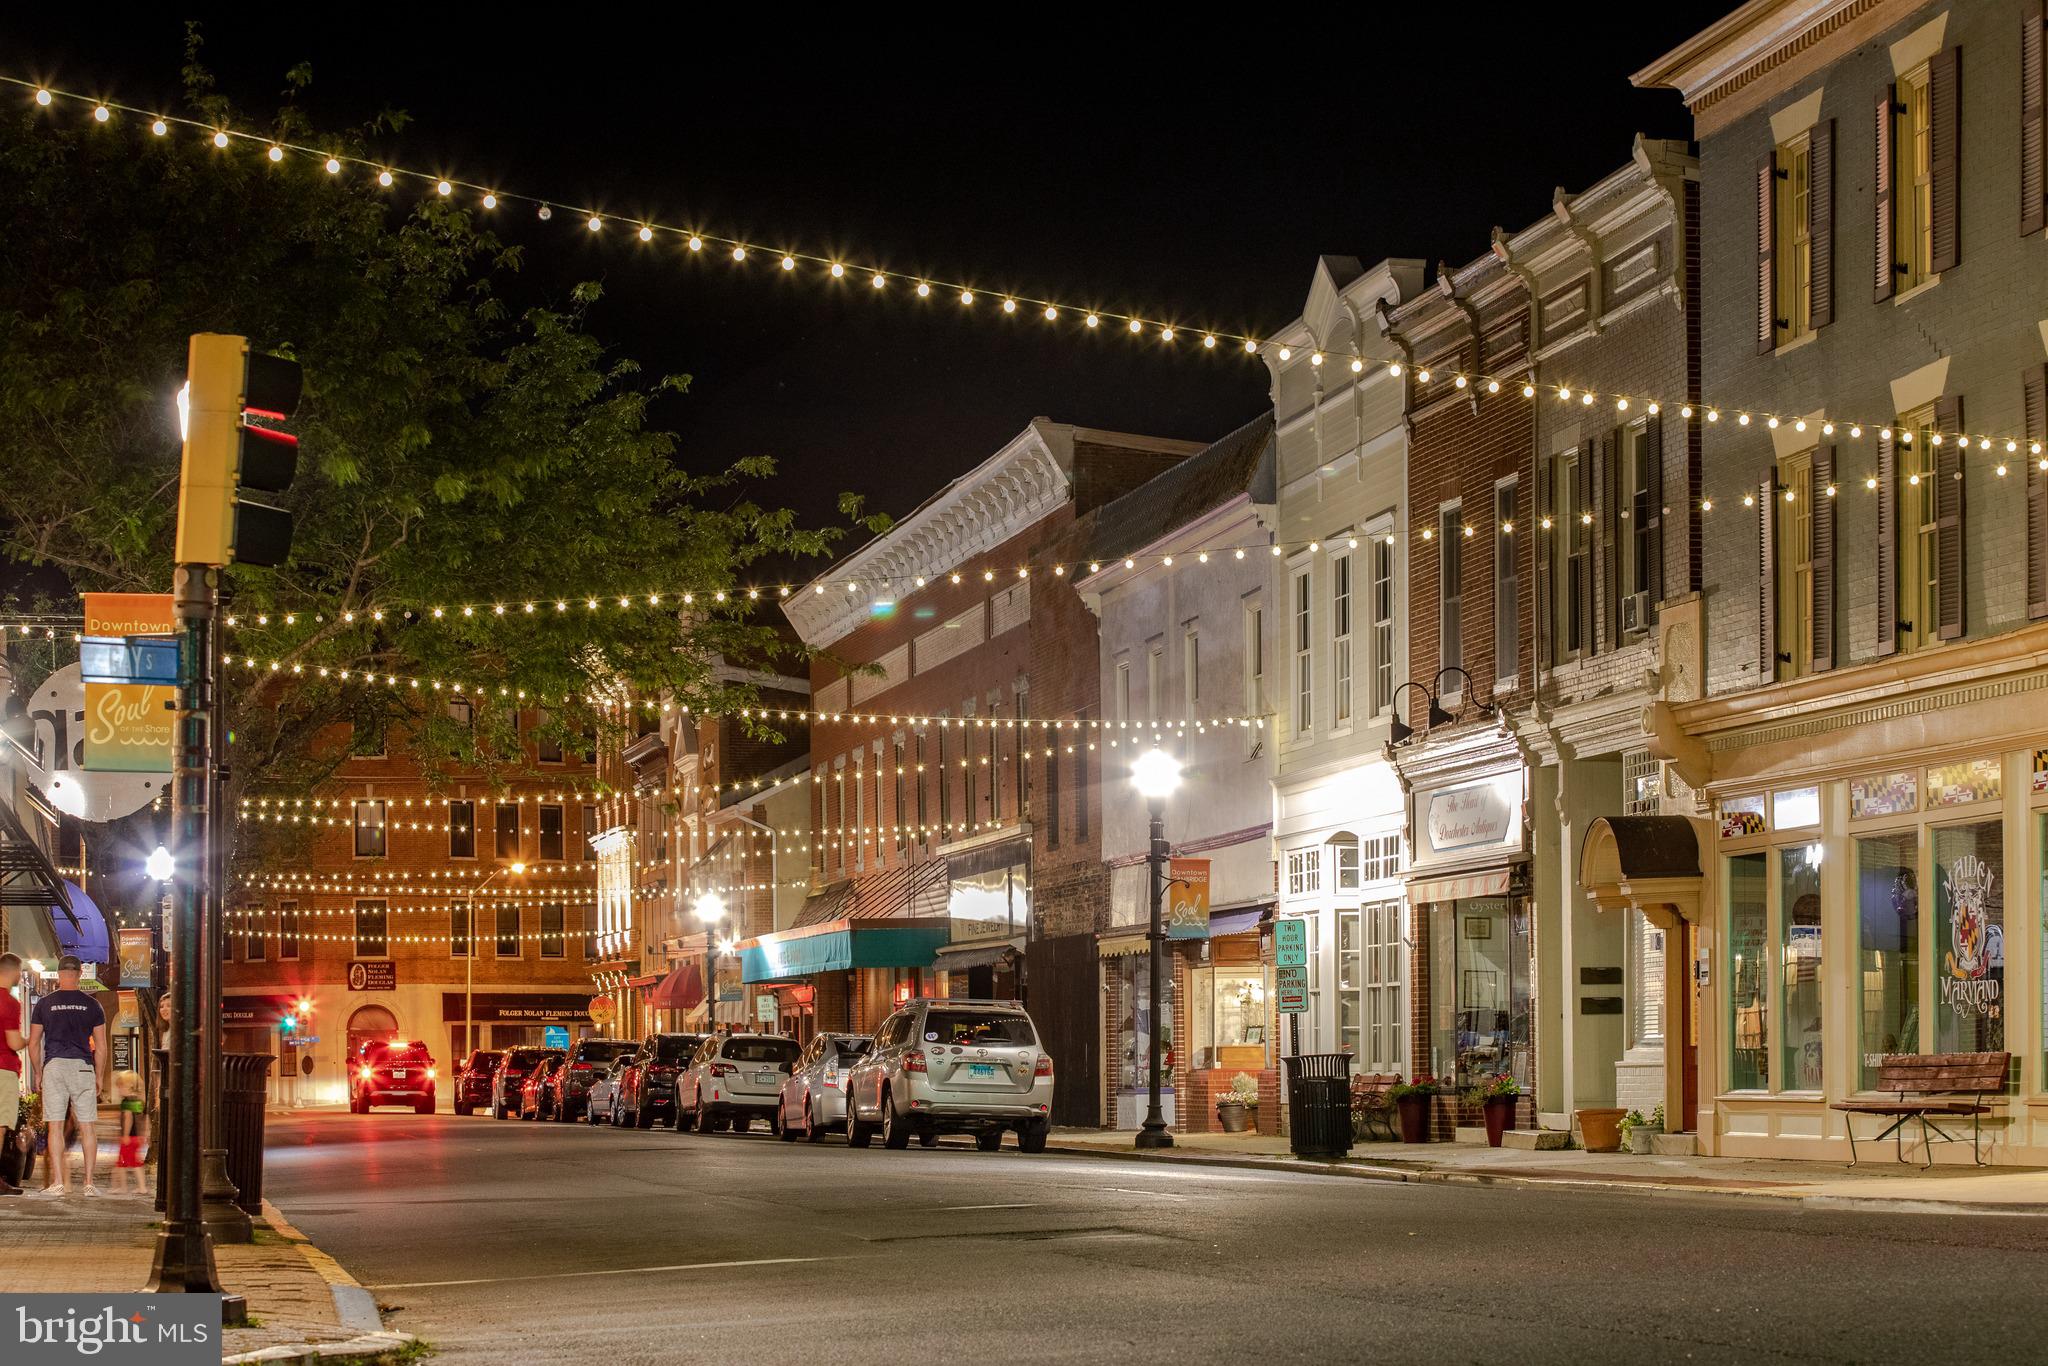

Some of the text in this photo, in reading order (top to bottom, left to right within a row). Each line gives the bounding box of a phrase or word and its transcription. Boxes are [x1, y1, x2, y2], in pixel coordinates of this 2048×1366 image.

[90, 618, 171, 633] Downtown
[90, 685, 156, 745] Soul
[145, 725, 171, 734] Shore
[1171, 894, 1202, 926] Soul
[1469, 901, 1505, 912] Oyster
[1284, 924, 1296, 932] TWO
[1278, 943, 1304, 952] PARKING
[1283, 953, 1299, 962] ONLY
[1285, 969, 1298, 978] NO
[1279, 979, 1306, 989] PARKING
[499, 1009, 523, 1017] FOLGER
[523, 1009, 544, 1017] NOLAN
